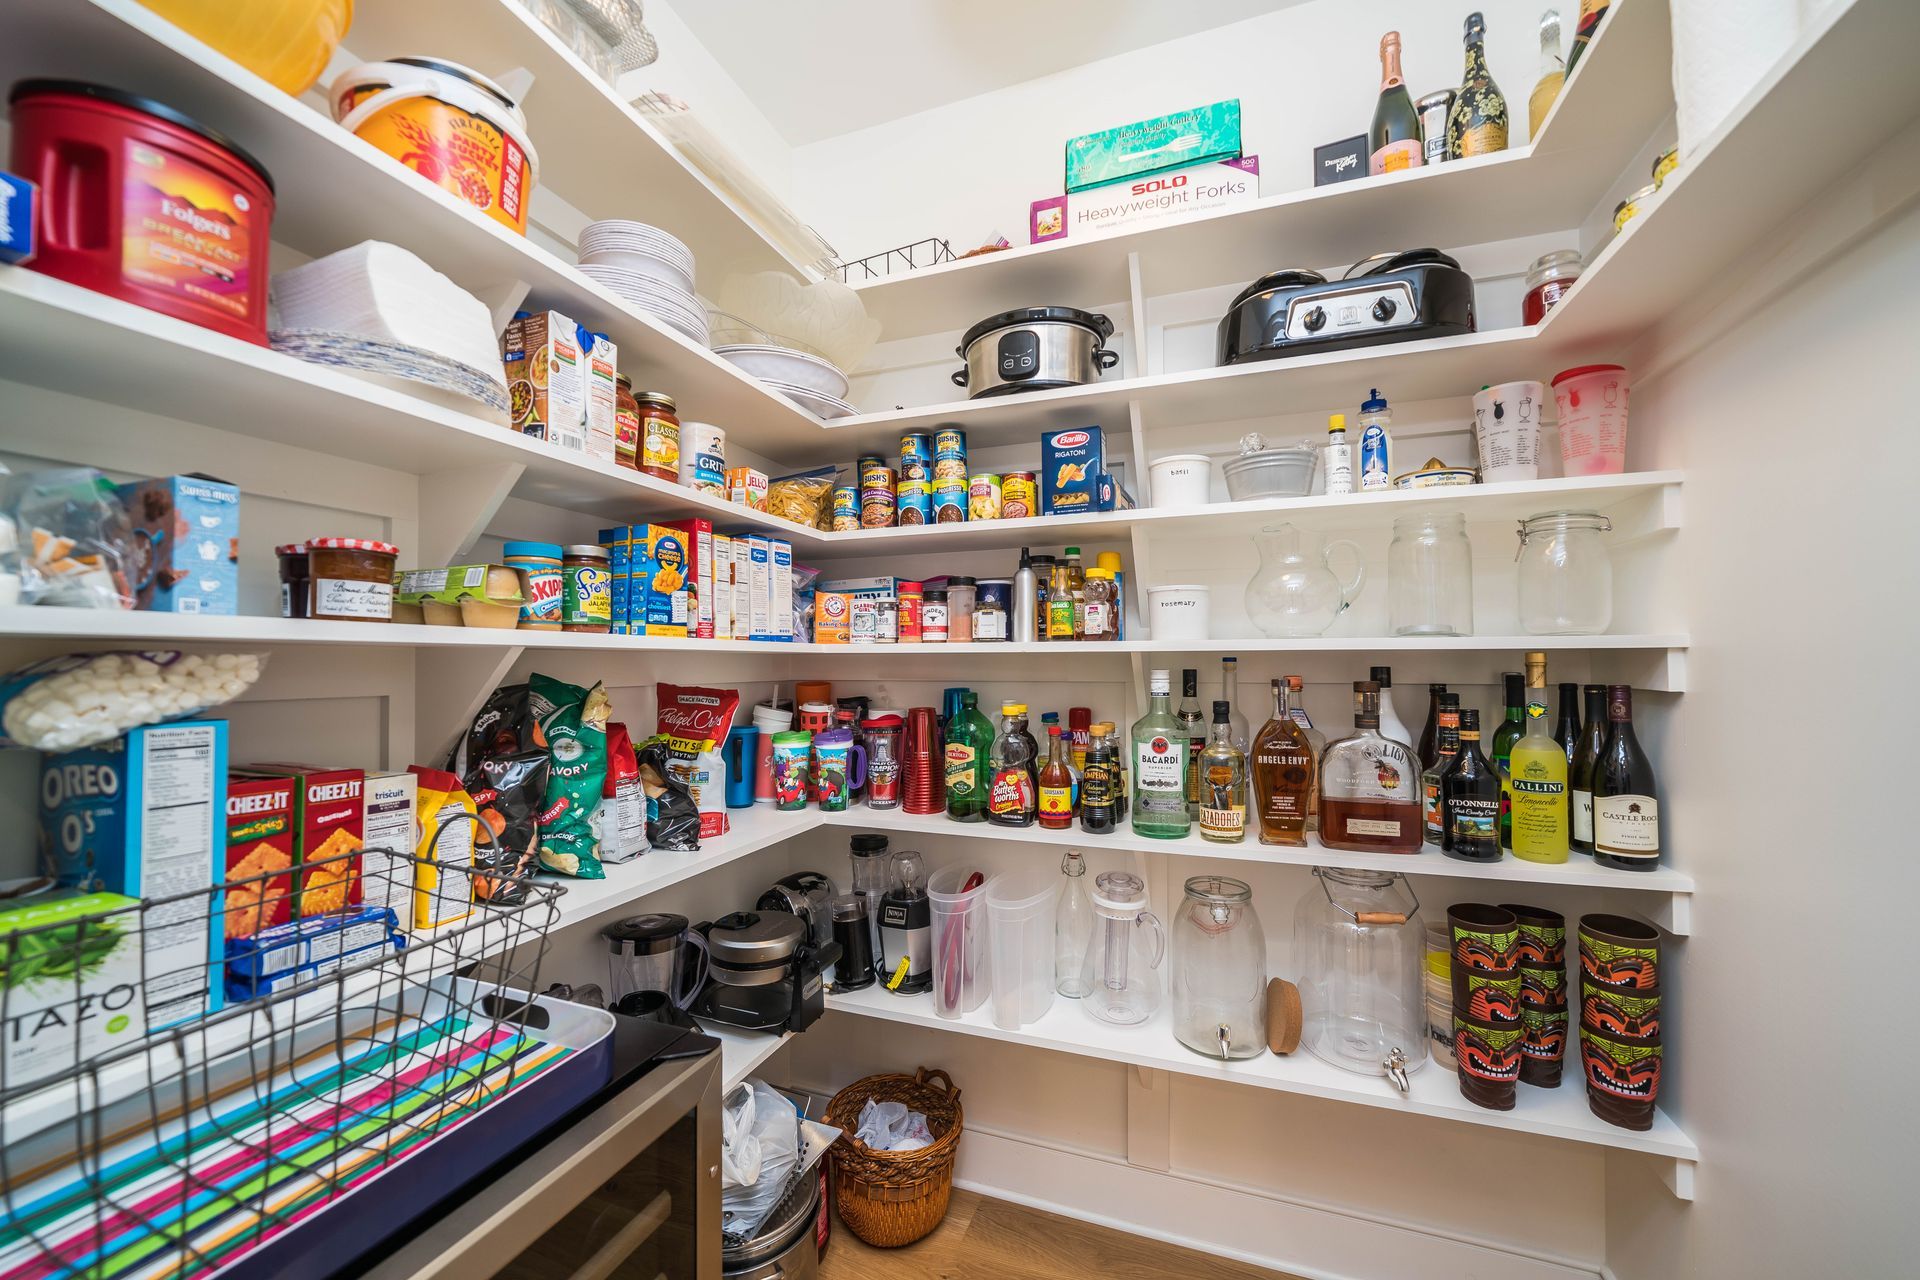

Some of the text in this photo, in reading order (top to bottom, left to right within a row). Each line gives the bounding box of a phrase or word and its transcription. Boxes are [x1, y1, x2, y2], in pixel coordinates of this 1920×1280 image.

[1131, 174, 1188, 197] SOLO
[1077, 180, 1247, 224] Heavyweight Forks
[938, 435, 960, 445] BUSH'S
[1059, 433, 1087, 445] Barilla
[1055, 449, 1086, 459] RIGATONI
[1170, 468, 1189, 476] basil
[864, 473, 887, 484] BUSH'S
[333, 581, 361, 594] Bonne
[1160, 600, 1197, 608] rosemary
[477, 713, 498, 729] SAUCY
[1288, 756, 1307, 766] ENVY
[550, 762, 589, 778] AVORY
[42, 763, 120, 810] OREO
[1514, 780, 1562, 792] PALLINI
[375, 789, 404, 801] triscuit
[1517, 794, 1558, 806] Limoncello
[540, 801, 566, 823] CRISPY
[1602, 811, 1640, 822] CASTLE
[254, 818, 285, 835] Spicy
[888, 909, 904, 918] NINJA
